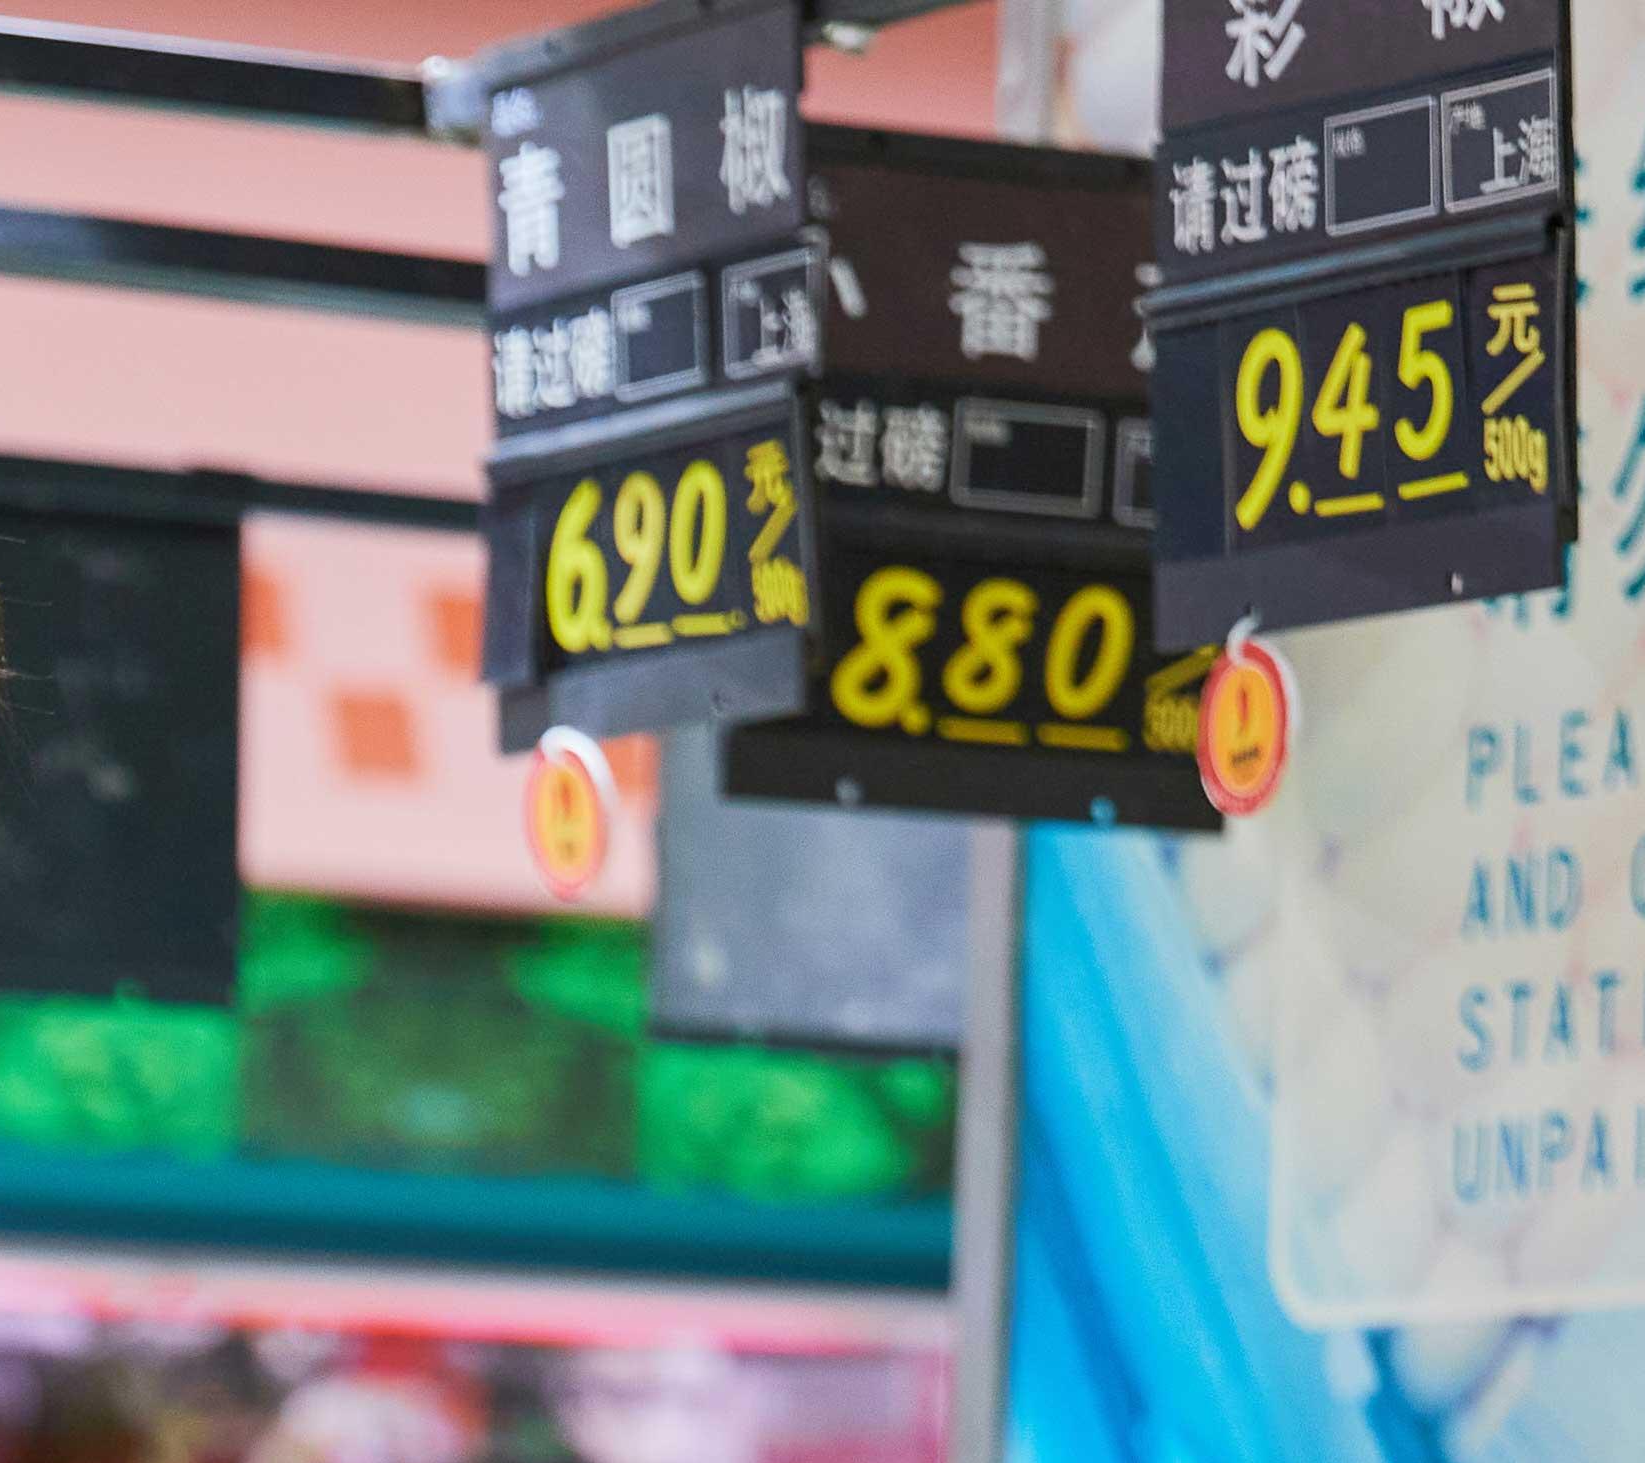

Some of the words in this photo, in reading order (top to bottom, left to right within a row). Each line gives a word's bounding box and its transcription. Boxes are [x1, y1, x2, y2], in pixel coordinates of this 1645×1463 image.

[1169, 135, 1320, 256] 请过磅
[814, 401, 949, 494] 过磅
[1235, 299, 1454, 531] 9.45
[1483, 413, 1549, 494] 500g
[546, 459, 727, 652] 6.90
[830, 567, 1135, 738] 8.80
[1462, 845, 1583, 938] AND
